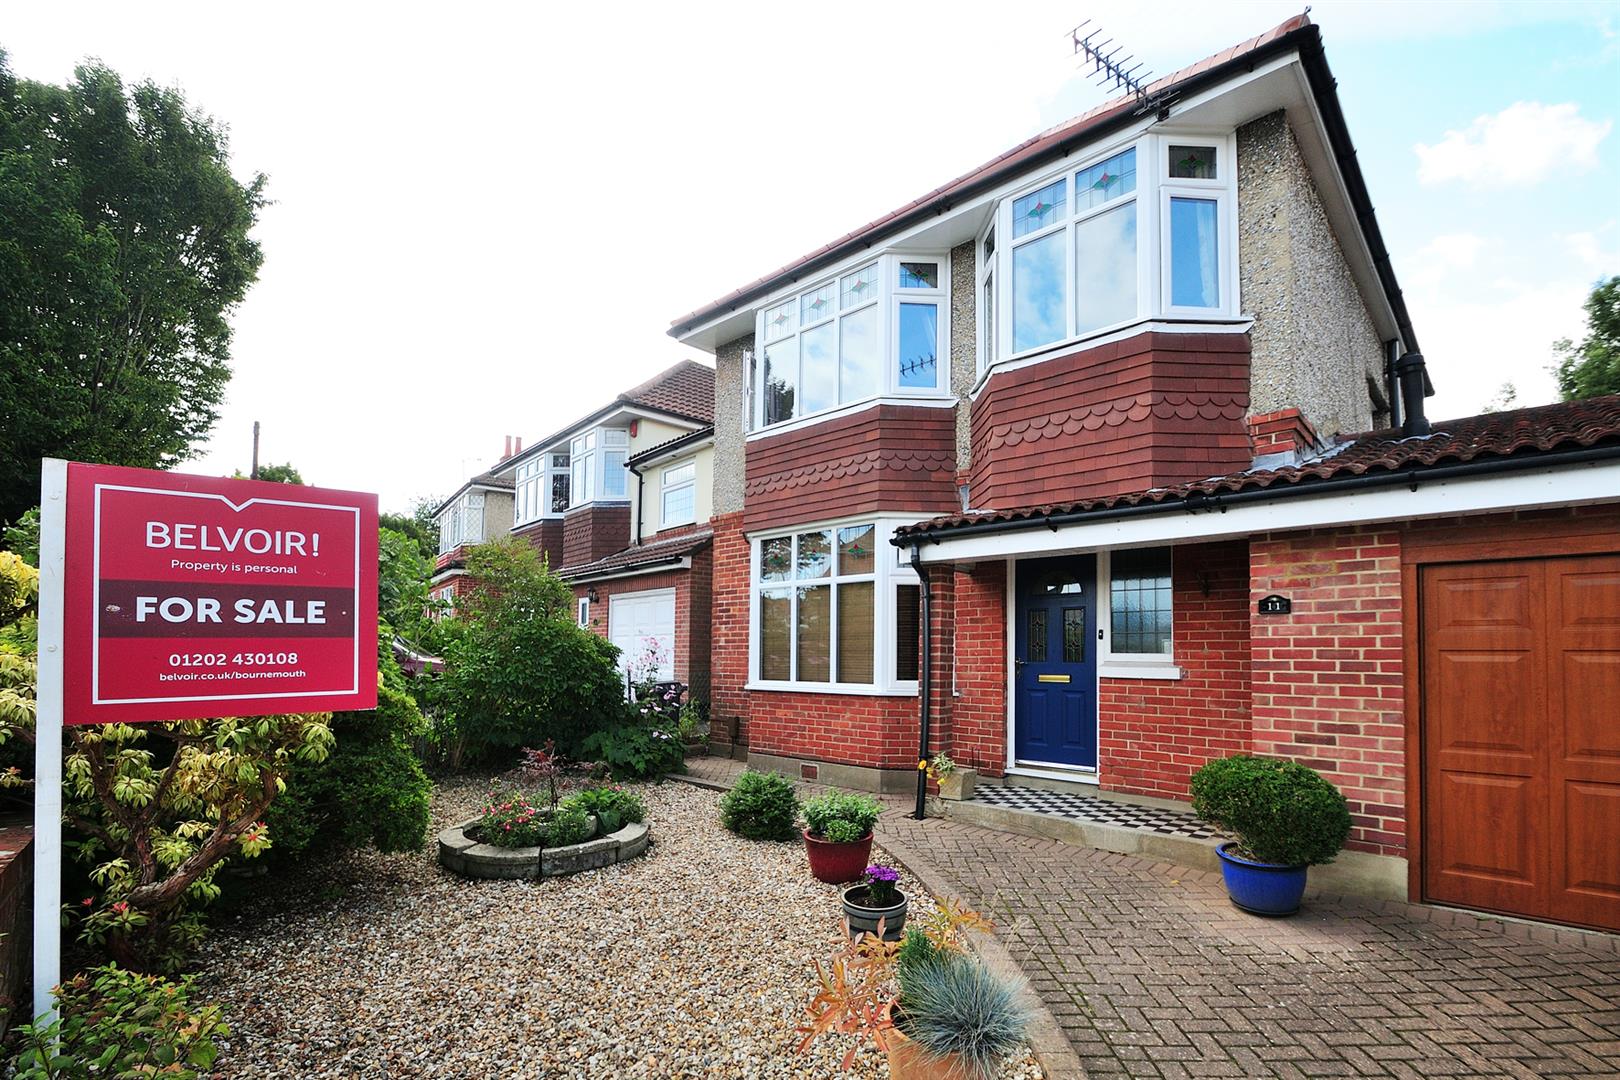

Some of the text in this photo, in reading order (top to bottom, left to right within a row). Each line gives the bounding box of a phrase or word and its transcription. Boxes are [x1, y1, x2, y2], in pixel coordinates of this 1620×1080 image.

[146, 521, 319, 557] BELVOIR!
[171, 560, 298, 574] Property is personal
[136, 596, 326, 624] FOR SALE
[1268, 602, 1280, 610] 11
[168, 652, 298, 666] 01202 430108
[160, 670, 306, 682] belvoir.co.uk/bournemouth
